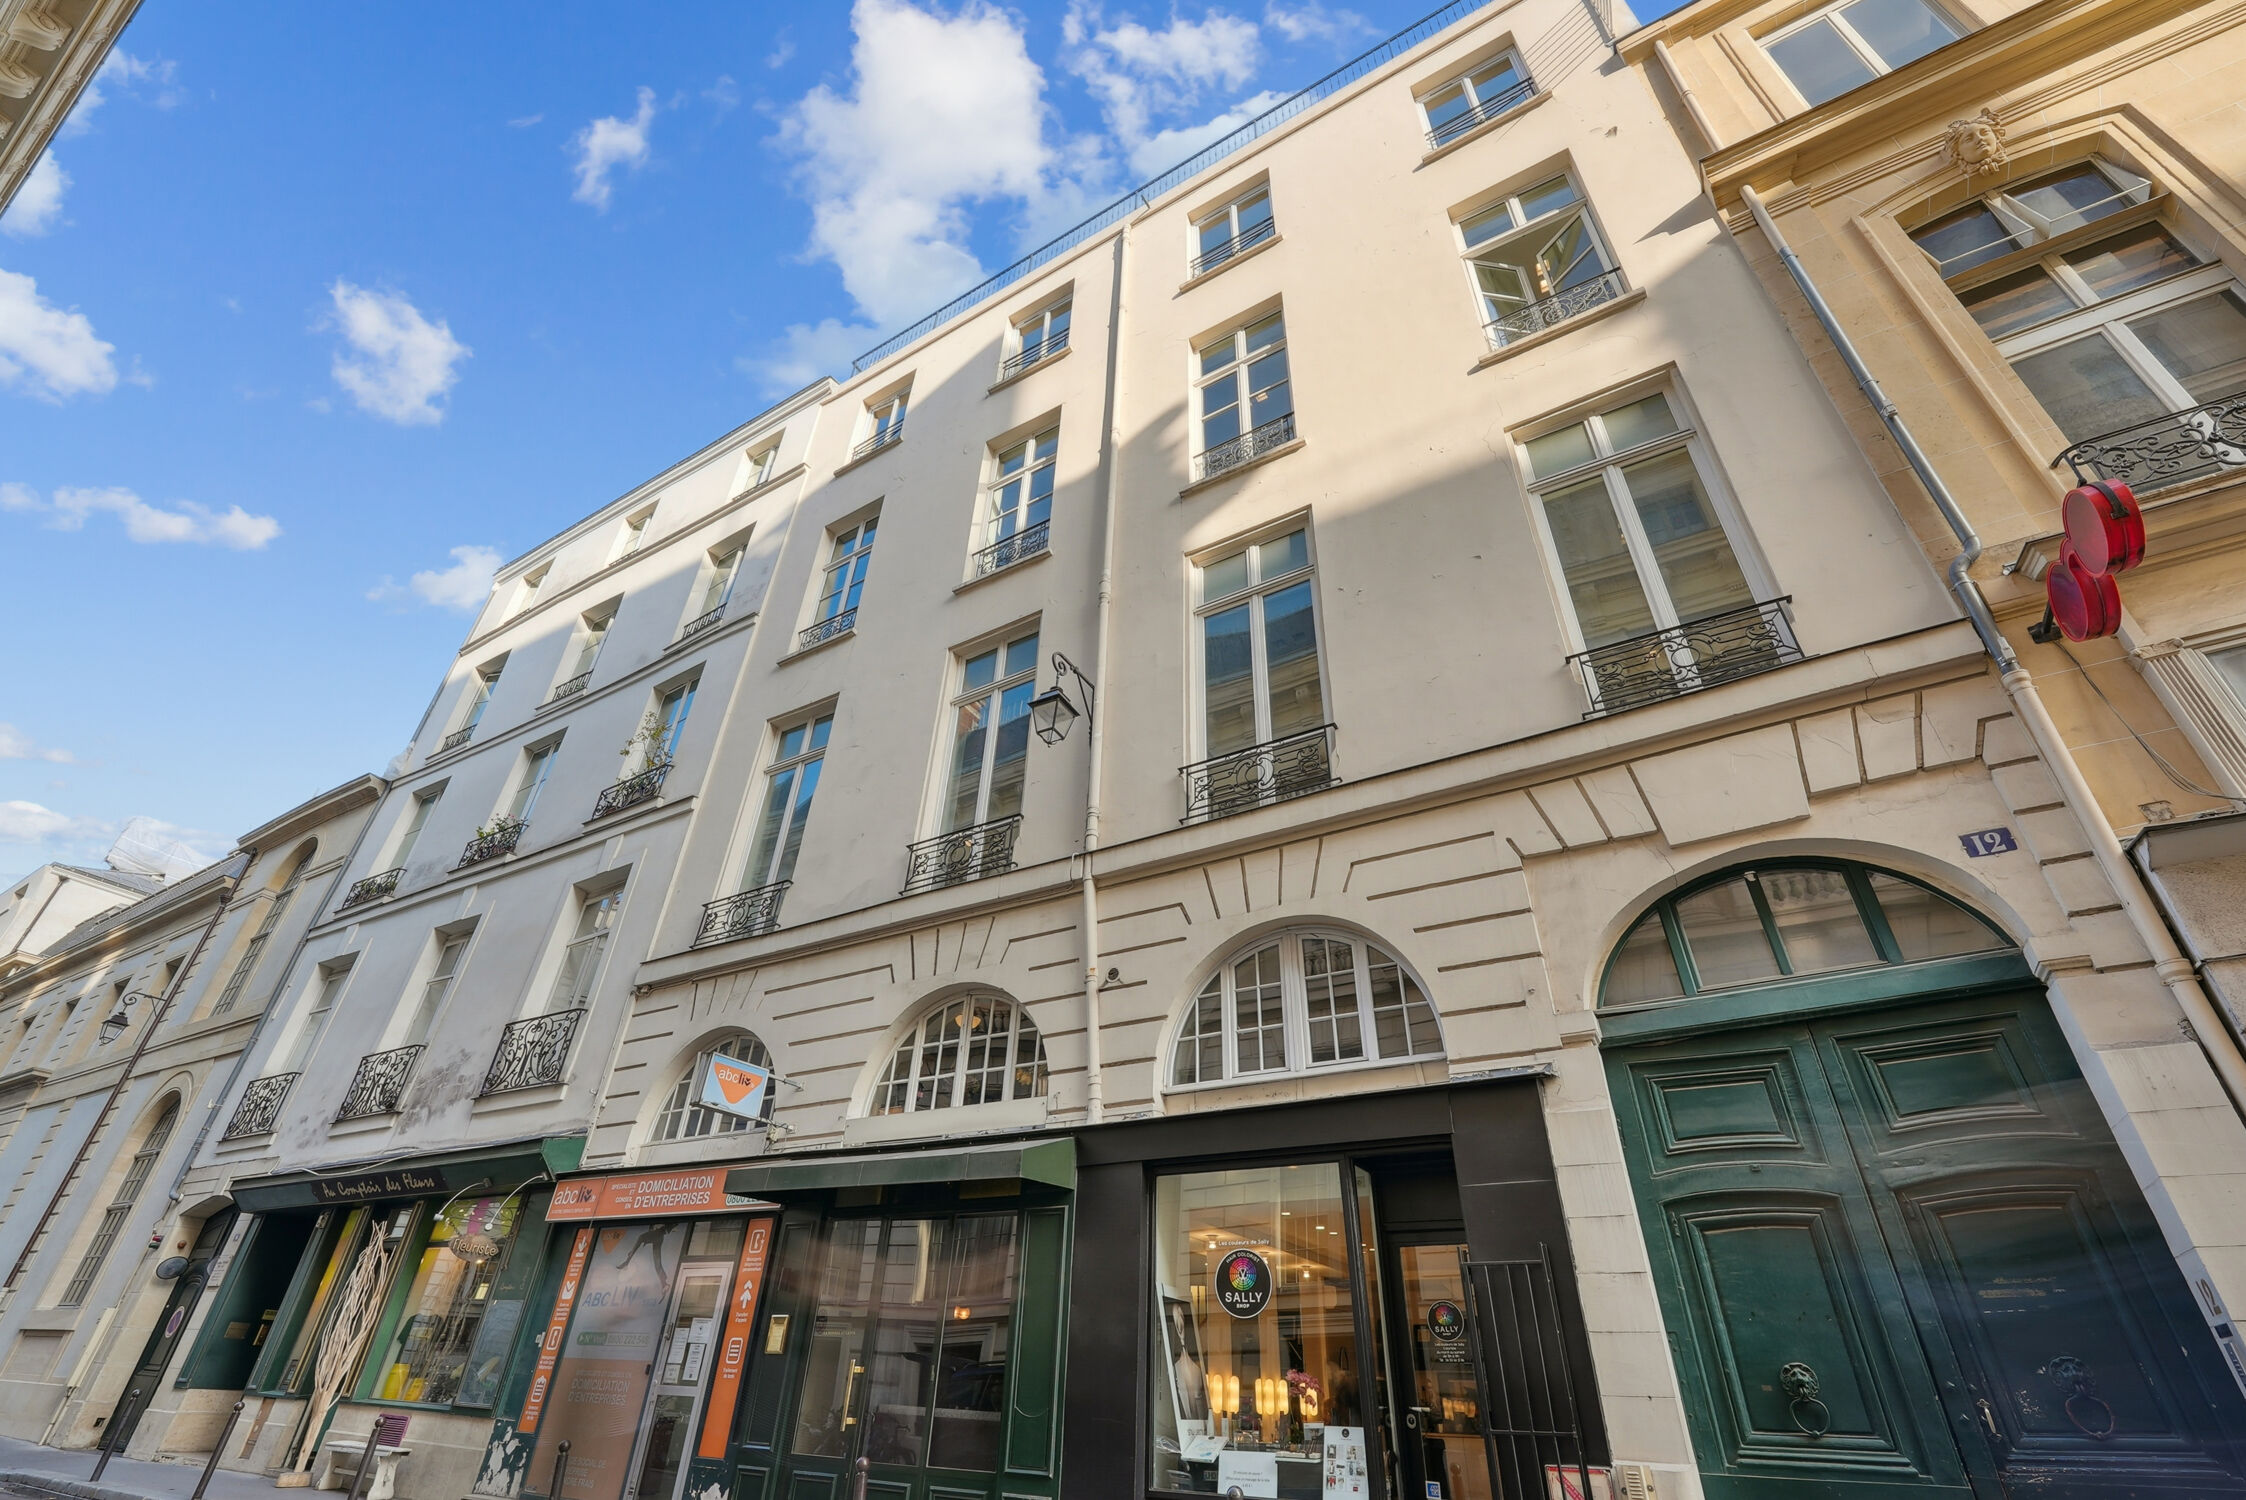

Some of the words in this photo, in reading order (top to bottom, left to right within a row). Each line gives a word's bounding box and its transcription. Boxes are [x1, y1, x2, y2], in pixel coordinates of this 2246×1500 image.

[1970, 832, 2008, 856] 12
[321, 1181, 337, 1198] Au
[385, 1176, 401, 1192] des
[638, 1175, 715, 1194] DOMICILIATION
[633, 1191, 711, 1209] D'ENTREPRISES
[1225, 1291, 1263, 1303] SALLY
[1434, 1325, 1459, 1333] SALLY
[571, 1378, 631, 1393] DOMICILIATION
